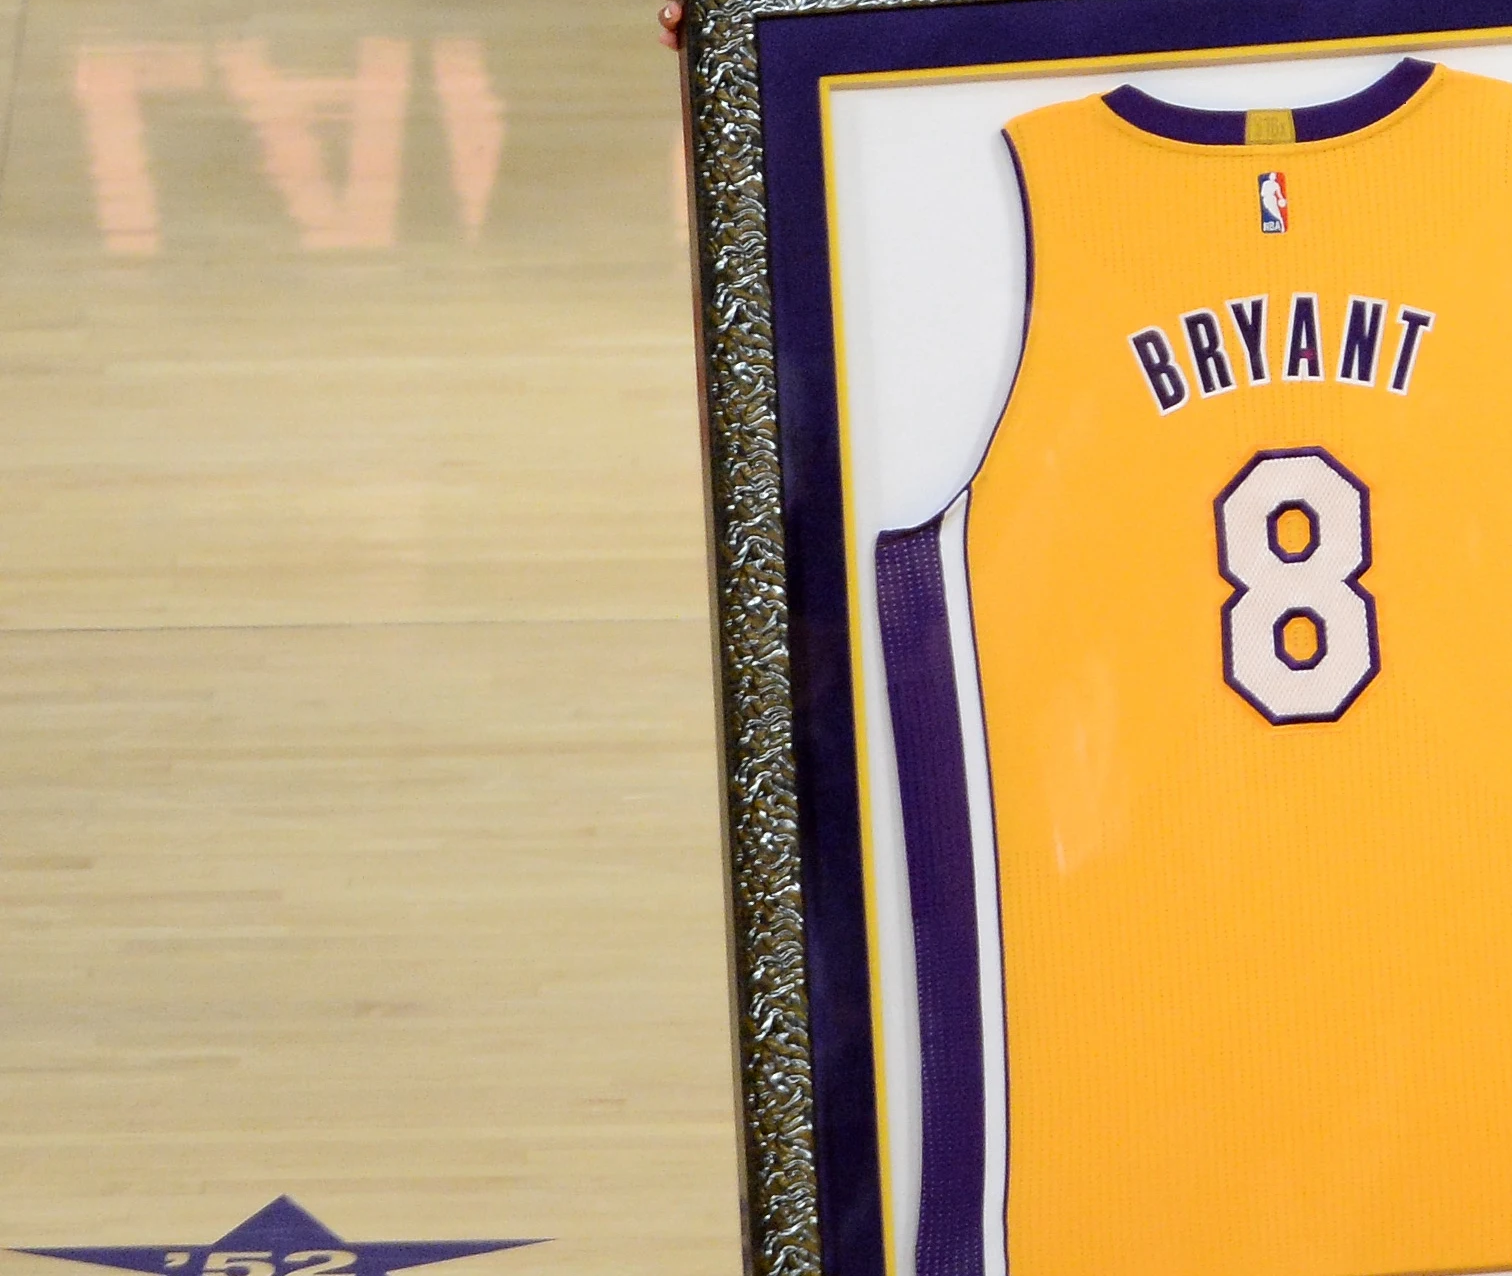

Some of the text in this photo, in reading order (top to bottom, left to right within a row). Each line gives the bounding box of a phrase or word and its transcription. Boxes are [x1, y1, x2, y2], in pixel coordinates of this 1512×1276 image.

[1263, 220, 1282, 232] NBA
[1128, 291, 1436, 417] BRYANT
[1212, 445, 1382, 727] 8
